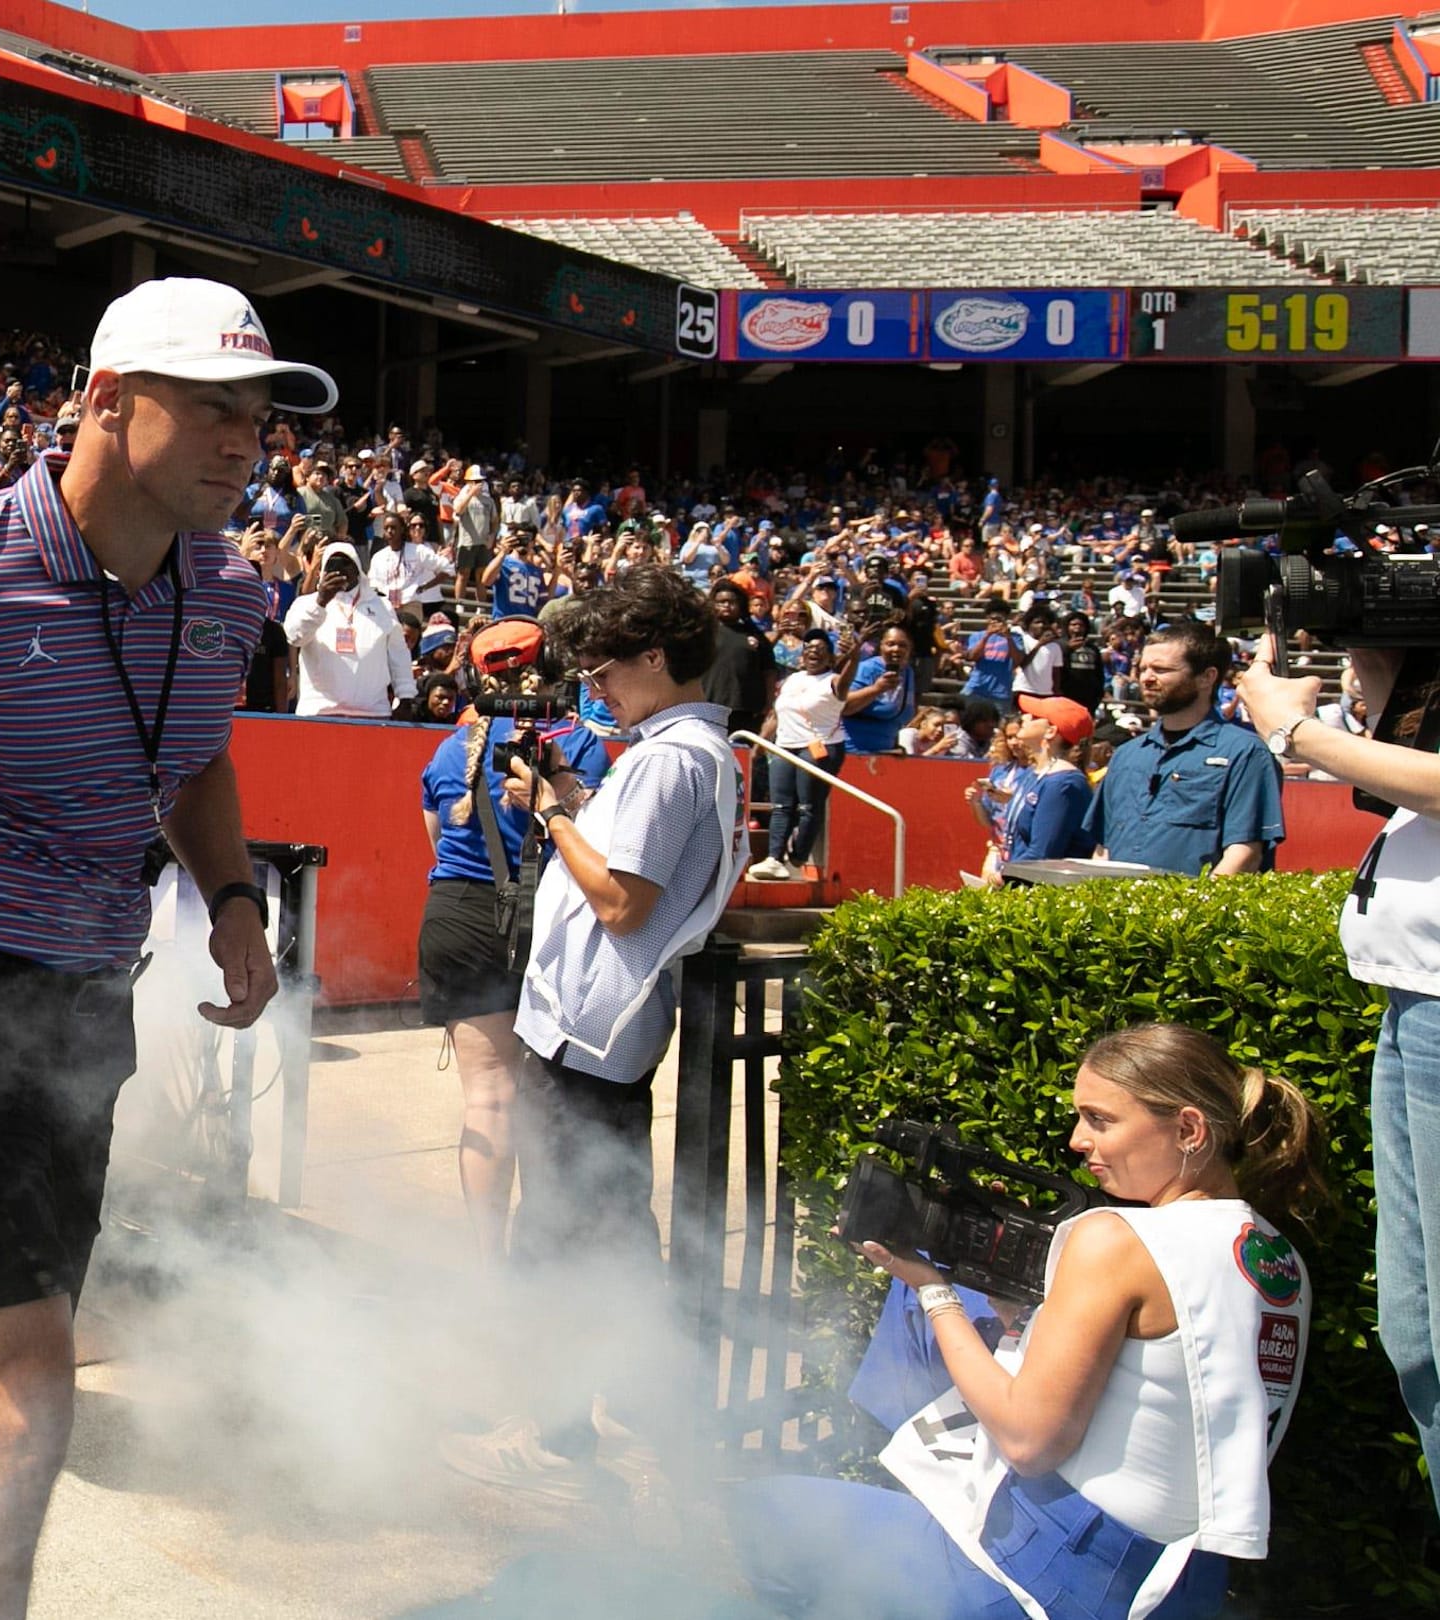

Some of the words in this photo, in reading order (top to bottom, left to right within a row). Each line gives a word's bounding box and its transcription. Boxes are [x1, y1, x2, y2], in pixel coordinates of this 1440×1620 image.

[1141, 291, 1176, 314] QTR
[679, 301, 715, 343] 25
[848, 301, 875, 346] 0
[1047, 299, 1075, 346] 0
[1152, 318, 1166, 350] 1
[1226, 293, 1349, 351] 5:19
[508, 572, 541, 607] 25
[1271, 1323, 1296, 1340] FARM
[1259, 1339, 1296, 1360] BUREAU
